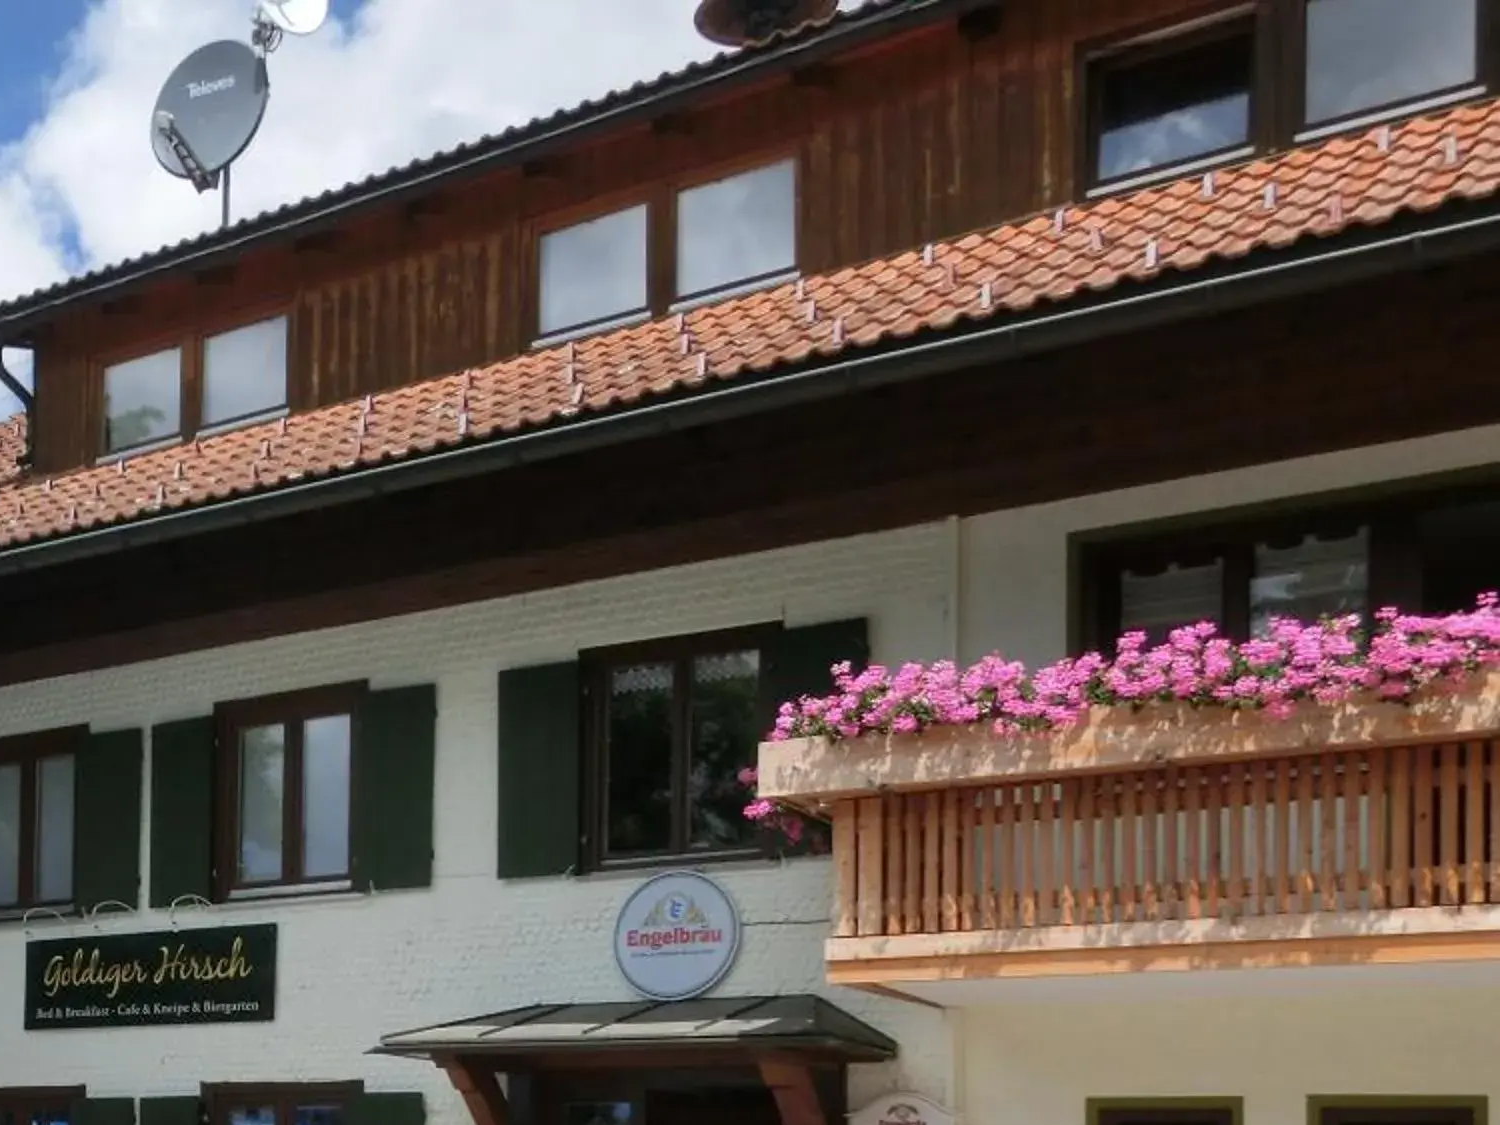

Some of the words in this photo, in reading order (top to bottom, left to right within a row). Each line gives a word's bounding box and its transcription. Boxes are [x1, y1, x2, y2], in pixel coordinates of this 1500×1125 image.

[43, 946, 148, 998] Goldiger
[153, 935, 254, 985] Hirsch
[153, 1002, 190, 1017] Kneipe
[203, 1000, 260, 1015] Biergarten
